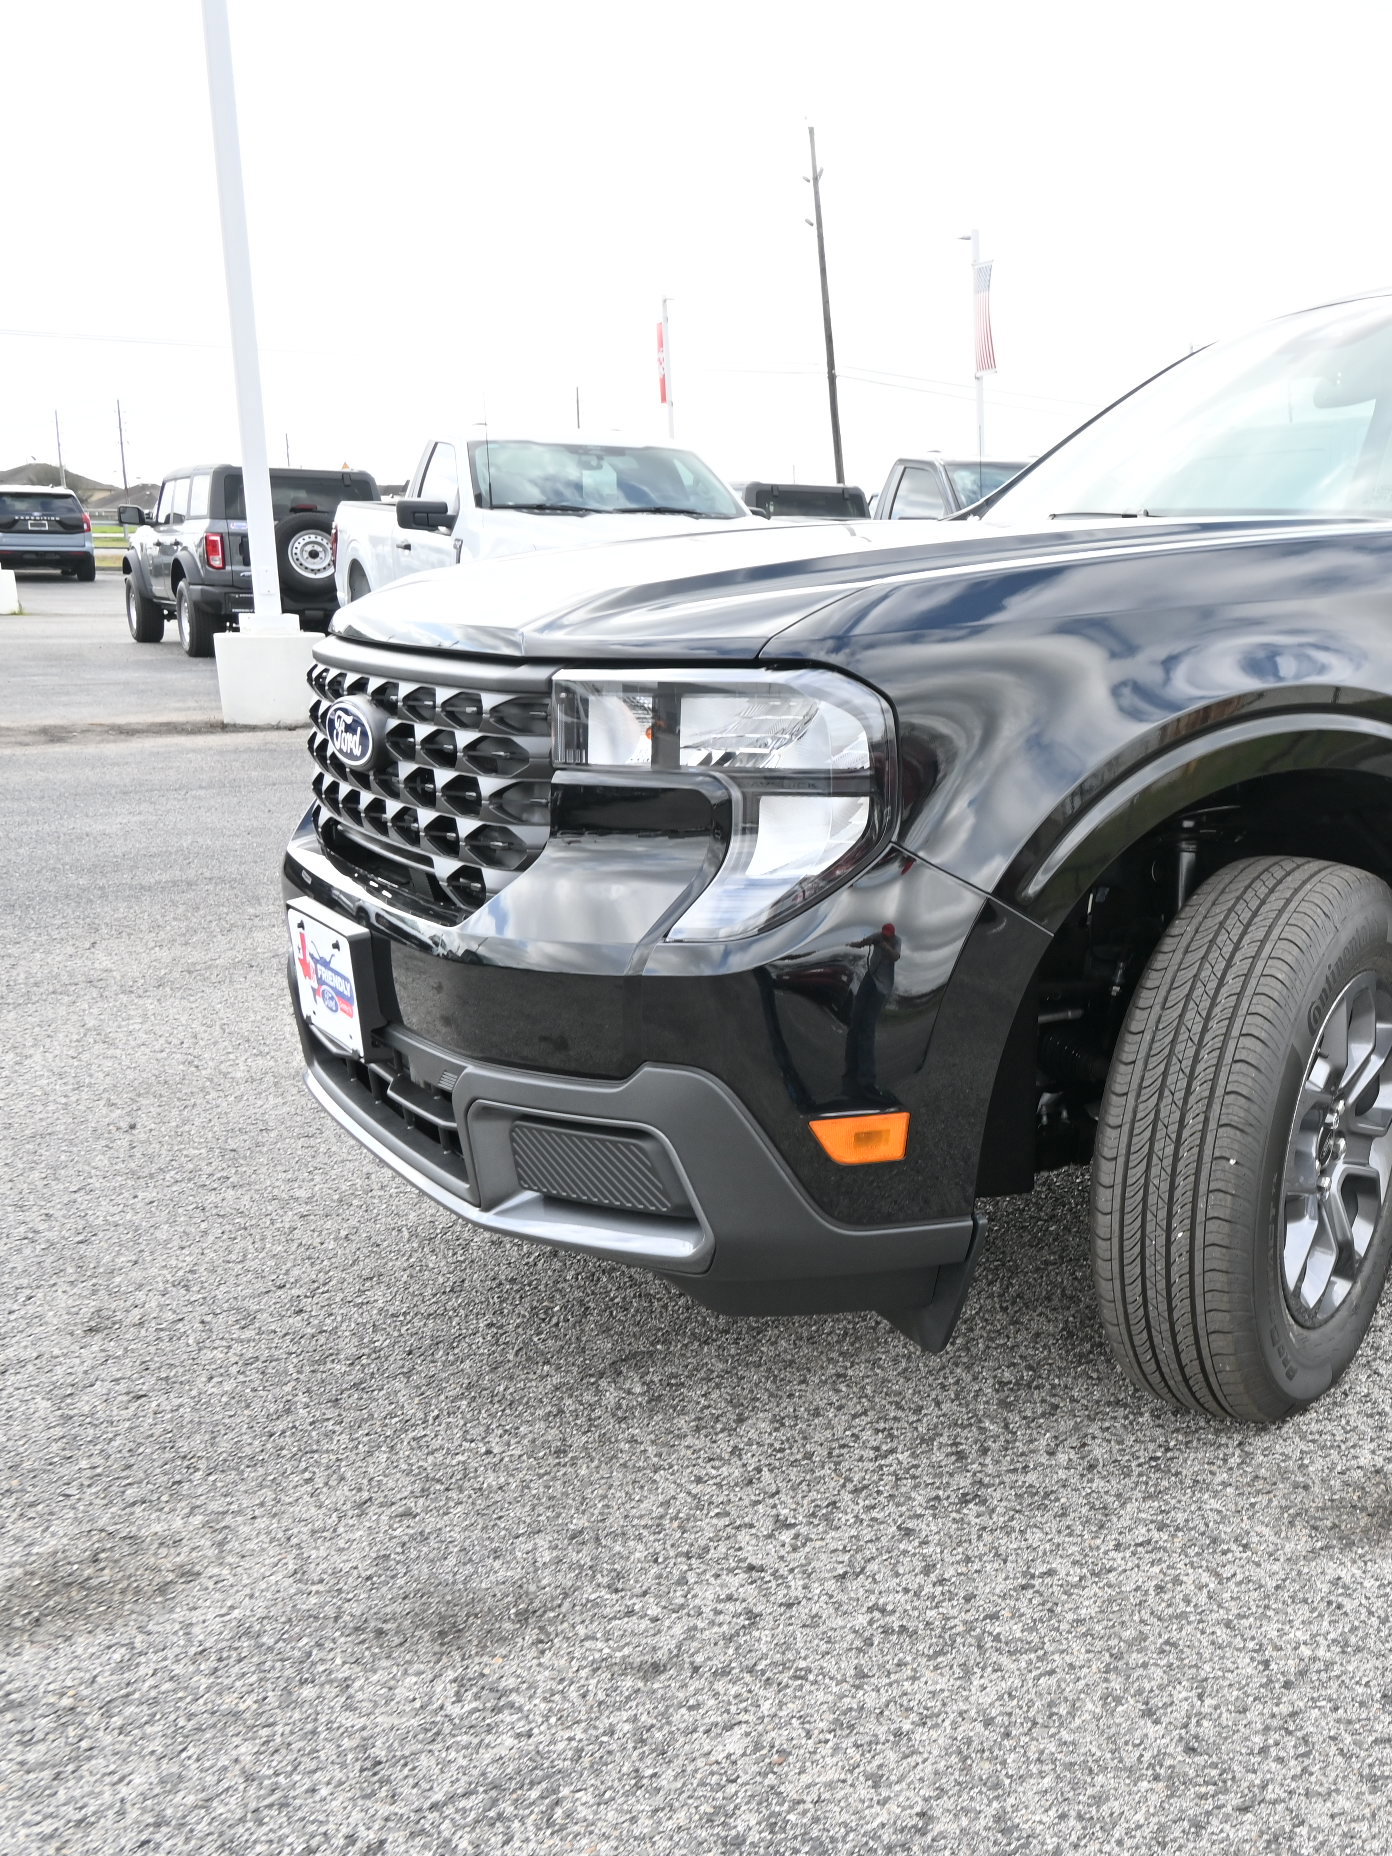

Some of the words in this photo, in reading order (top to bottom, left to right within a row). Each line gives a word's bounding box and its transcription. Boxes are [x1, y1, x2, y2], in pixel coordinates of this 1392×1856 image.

[333, 710, 363, 757] Ford
[316, 963, 352, 998] FRIENDLY
[1307, 913, 1374, 1036] Continental
